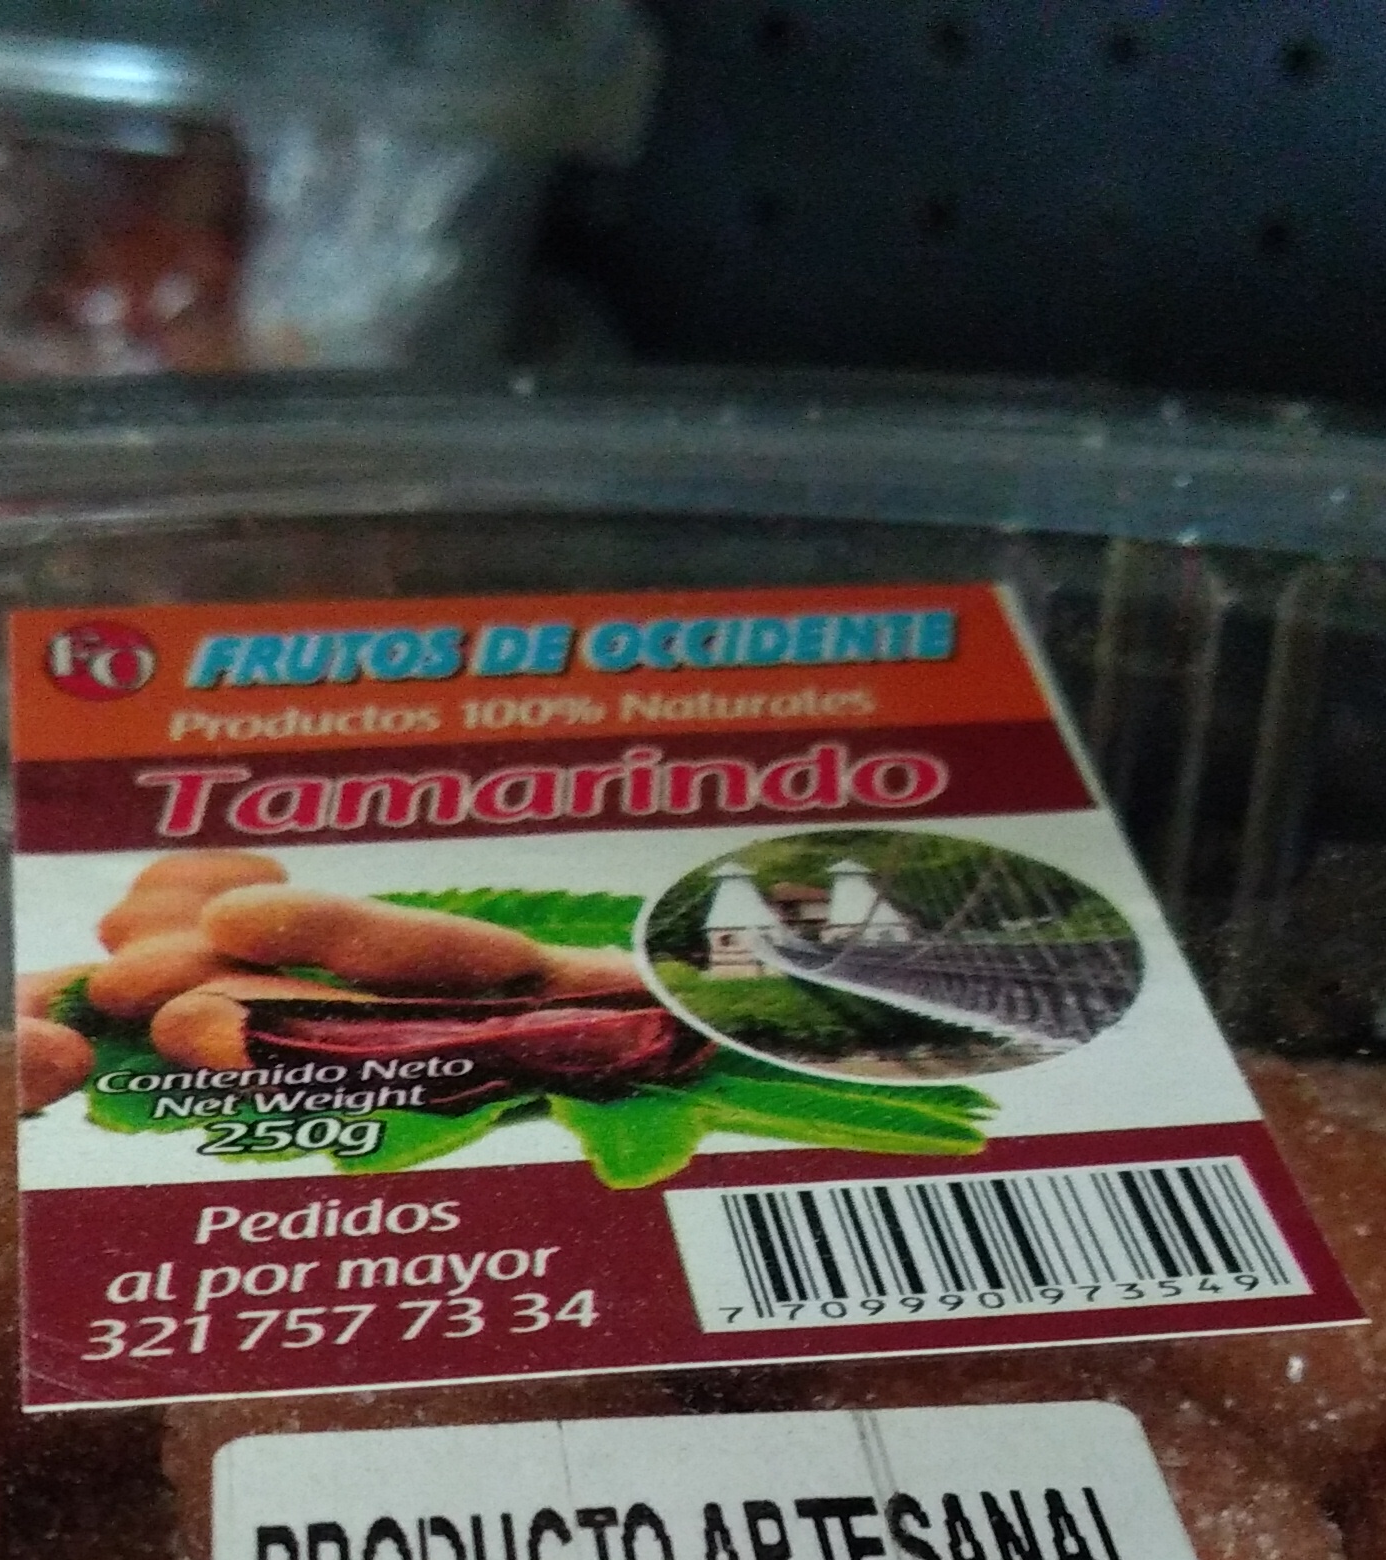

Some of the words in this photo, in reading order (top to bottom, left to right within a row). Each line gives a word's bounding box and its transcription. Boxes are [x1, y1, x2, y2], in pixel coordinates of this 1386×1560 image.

[186, 624, 466, 690] FRUTOS
[472, 622, 575, 678] DE
[586, 608, 959, 673] OCCIDENTE
[169, 703, 441, 743] Productos
[463, 695, 607, 730] 100%
[619, 686, 876, 725] Naturales
[137, 743, 950, 839] Tamarindo
[96, 1061, 348, 1094] Contenido
[360, 1055, 475, 1083] Neto
[152, 1095, 244, 1120] Net
[255, 1084, 428, 1117] Weight
[197, 1115, 386, 1157] 250g
[194, 1198, 461, 1245] Pedidos
[106, 1261, 176, 1303] al
[192, 1255, 321, 1312] por
[337, 1244, 560, 1297] mayor
[80, 1312, 218, 1361] 321
[236, 1302, 374, 1352] 757
[399, 1297, 485, 1341] 73
[510, 1288, 601, 1335] 34
